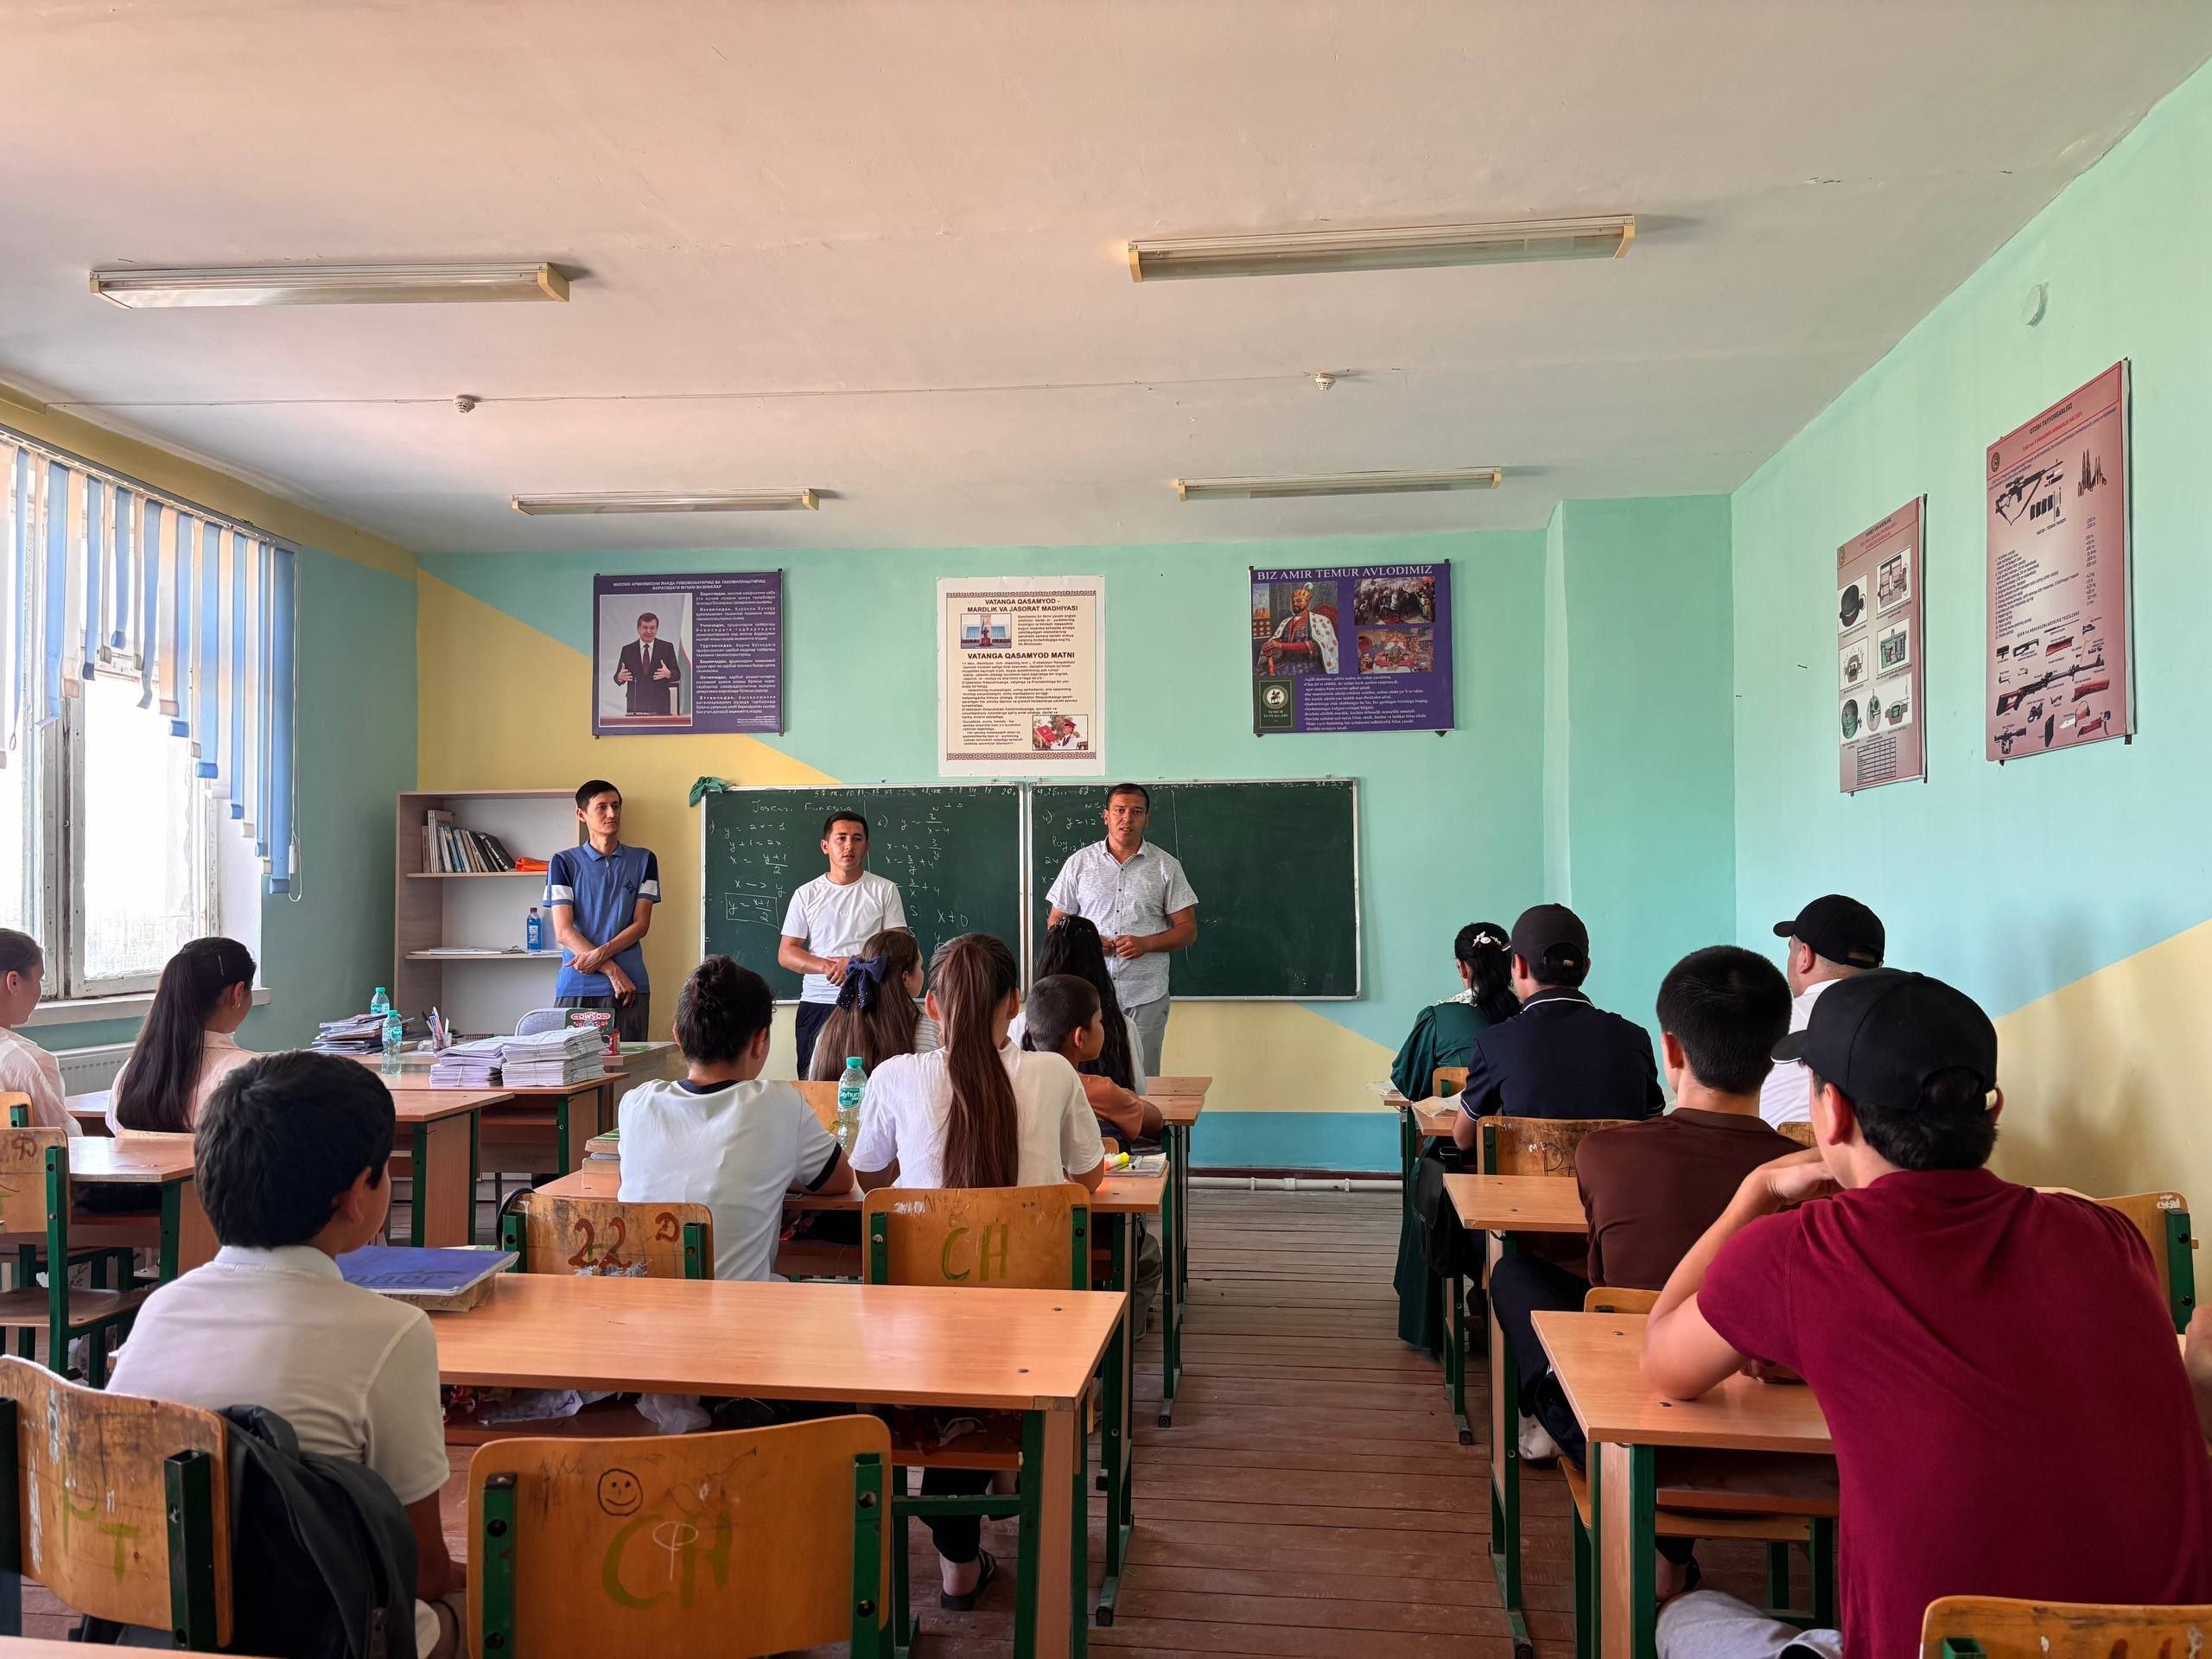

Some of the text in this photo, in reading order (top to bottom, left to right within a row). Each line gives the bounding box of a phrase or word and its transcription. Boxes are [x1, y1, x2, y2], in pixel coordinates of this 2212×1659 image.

[1257, 566, 1433, 580] BIZ AMIR TEMUR AVLODIMIZ
